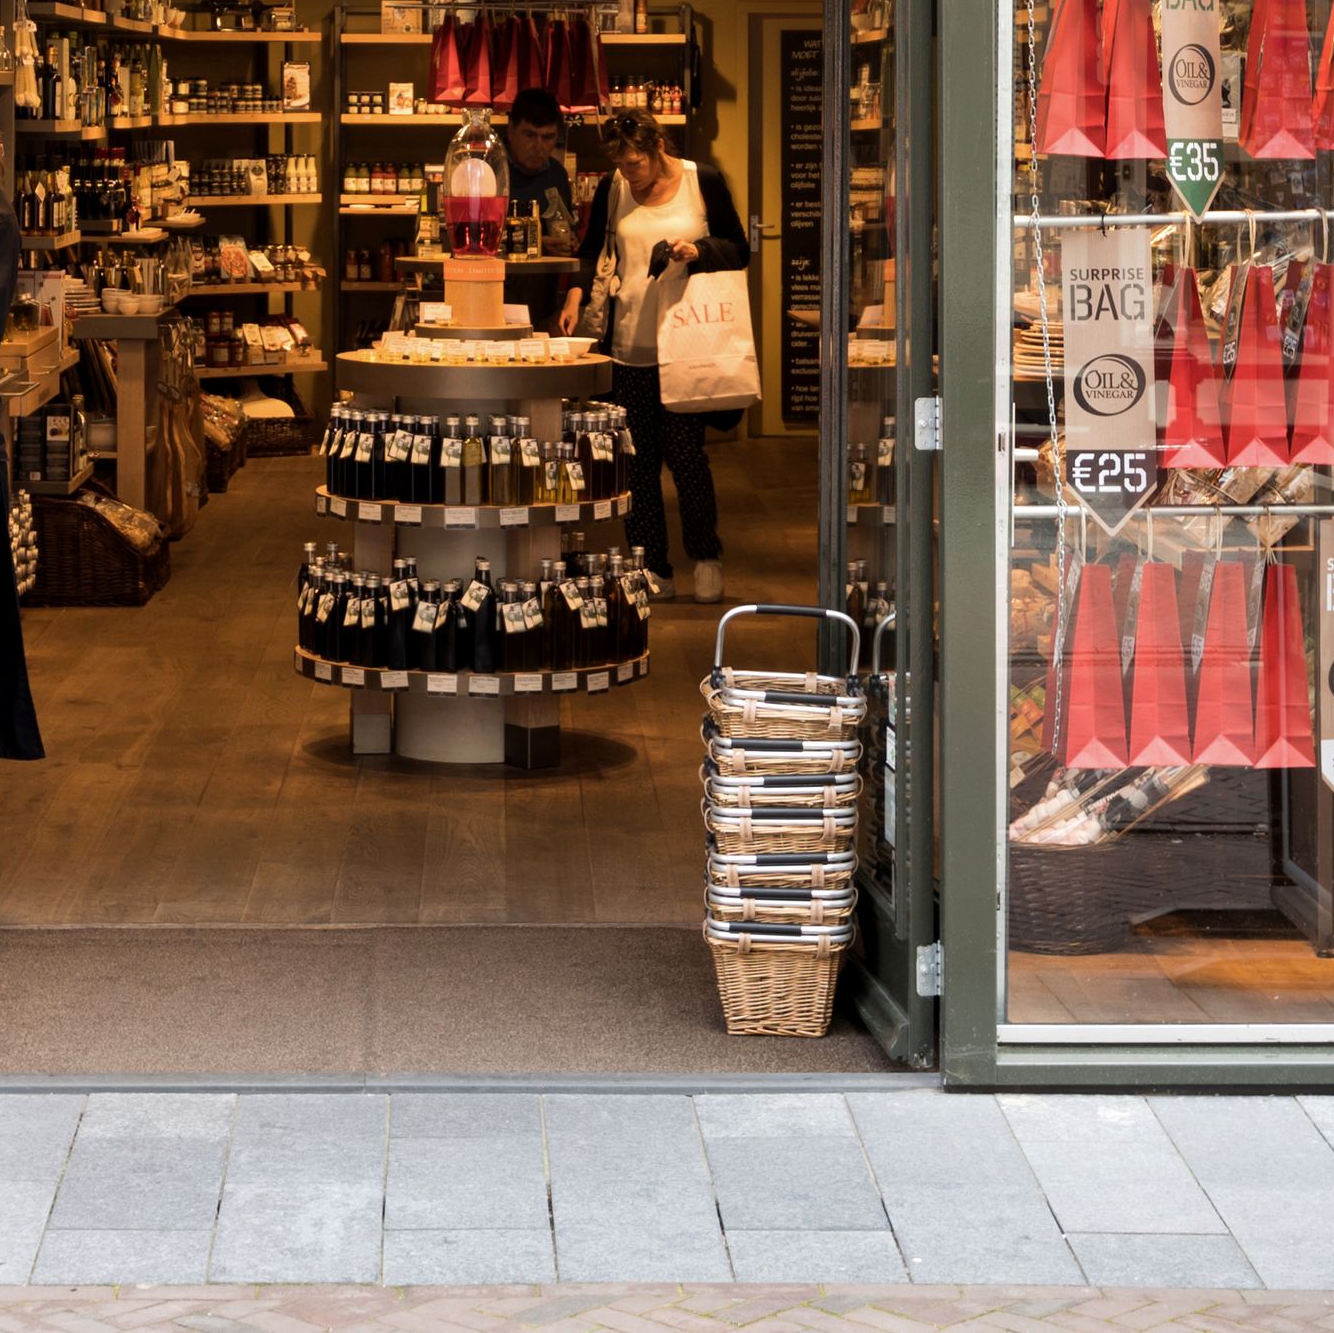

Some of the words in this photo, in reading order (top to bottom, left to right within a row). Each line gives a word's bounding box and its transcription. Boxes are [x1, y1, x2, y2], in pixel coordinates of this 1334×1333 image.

[1176, 79, 1209, 89] VINEGAR
[1169, 141, 1219, 181] €35
[1070, 267, 1144, 281] SURPRISE
[673, 302, 735, 328] SALE
[1070, 283, 1145, 321] BAG
[1085, 390, 1134, 399] VINEGAR
[1072, 453, 1147, 493] €25
